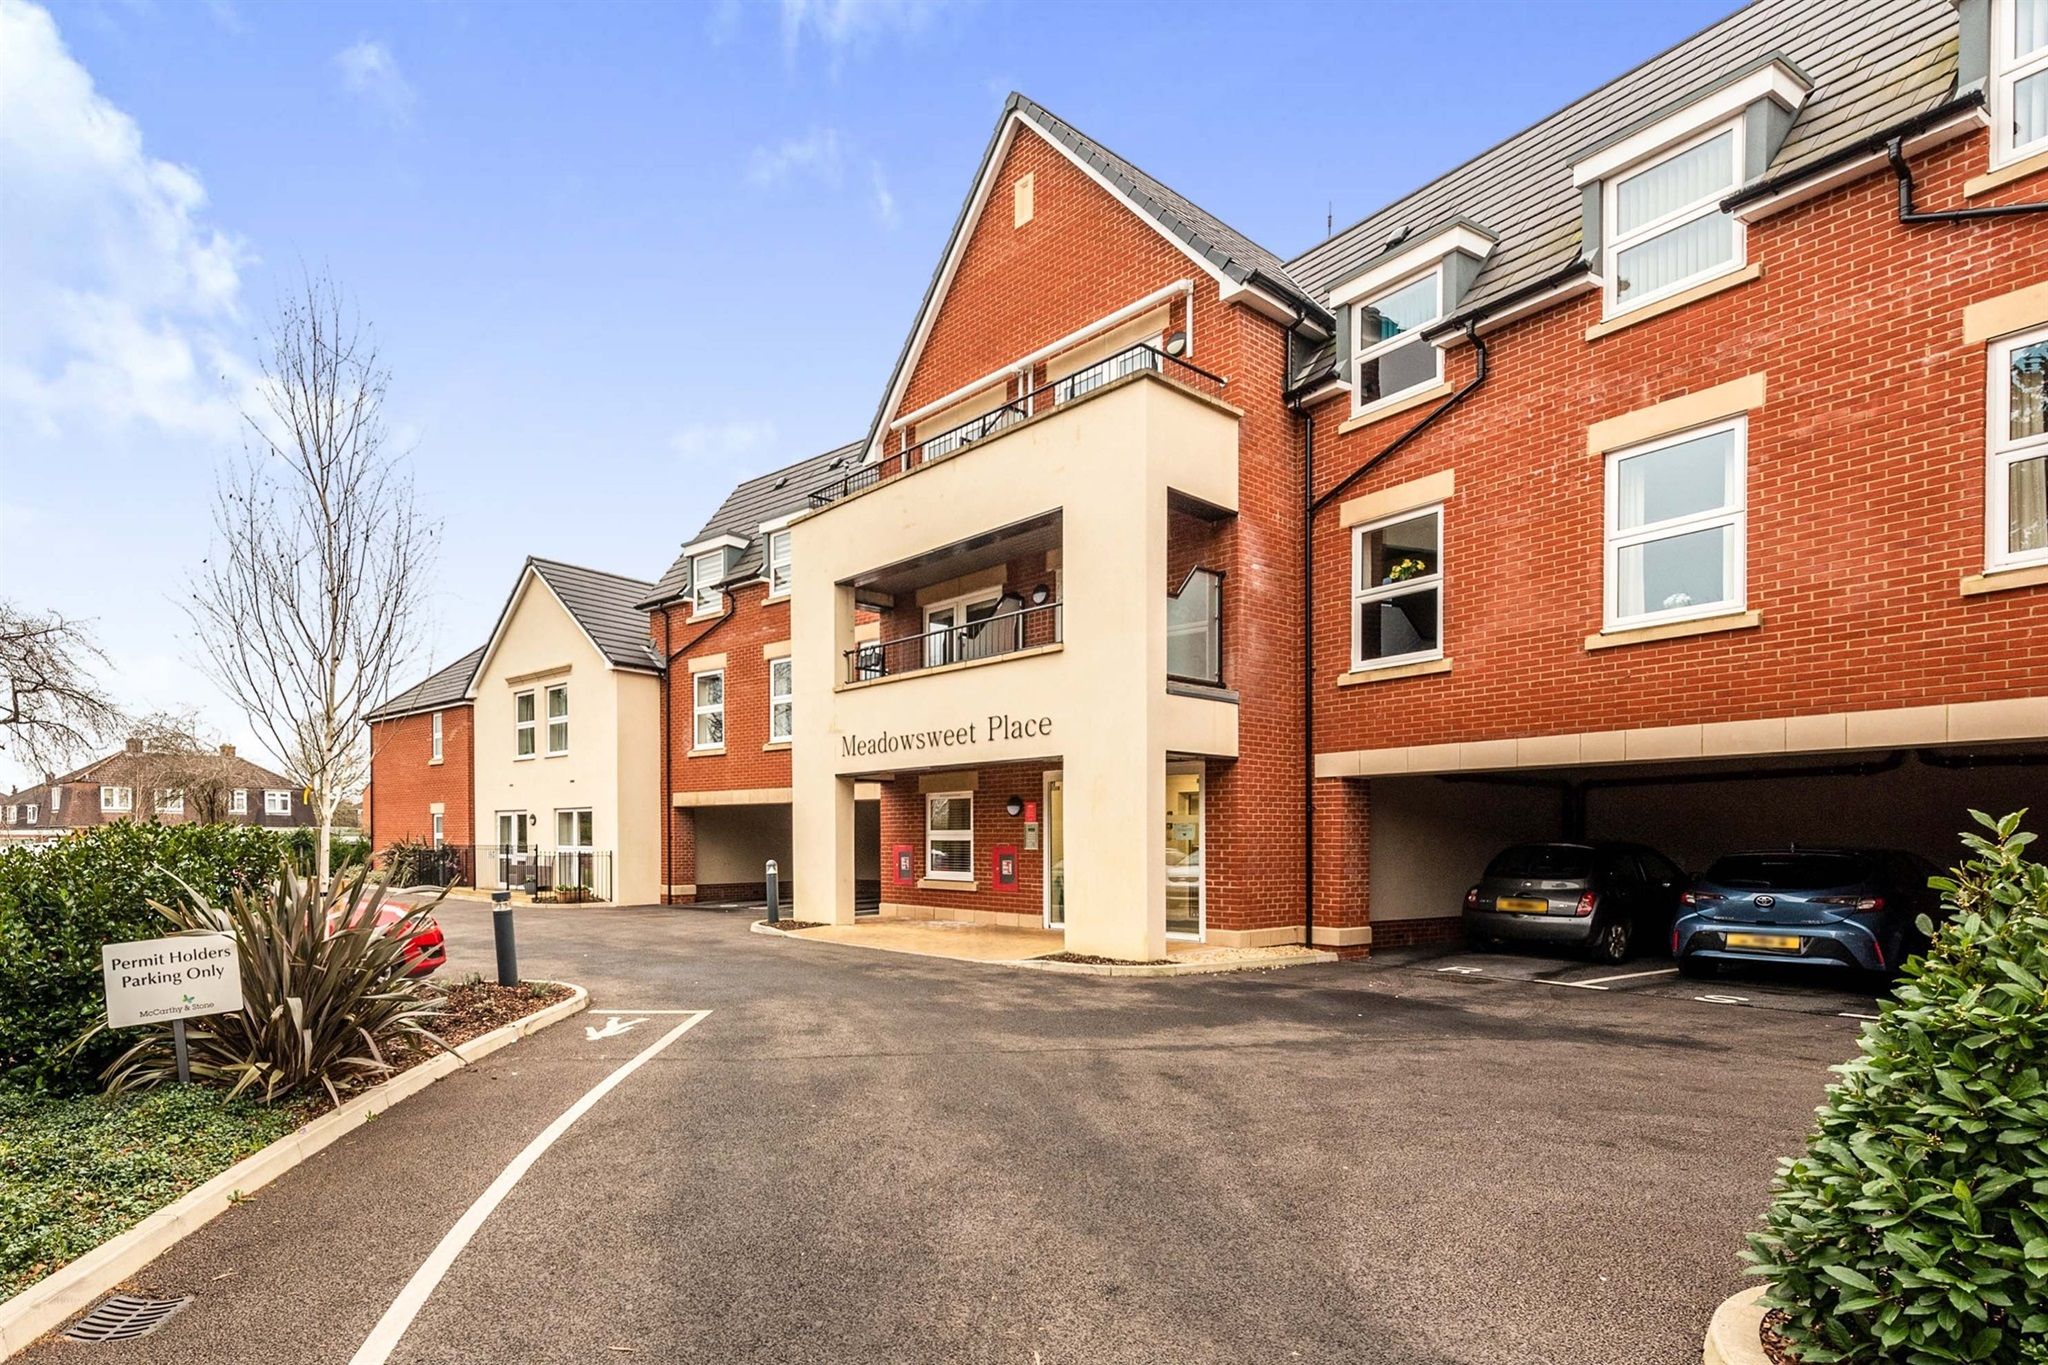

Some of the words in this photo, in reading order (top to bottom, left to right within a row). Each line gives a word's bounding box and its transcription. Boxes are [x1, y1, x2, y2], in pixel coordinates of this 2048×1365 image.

[841, 721, 977, 758] Meadowsweet
[987, 714, 1053, 742] Place
[111, 953, 165, 971] Permit
[169, 946, 231, 964] Holders
[121, 971, 182, 988] Parking
[186, 964, 225, 980] Only
[139, 1004, 183, 1018] McCarthy
[183, 1004, 191, 1012] &
[191, 1001, 215, 1011] Stone
